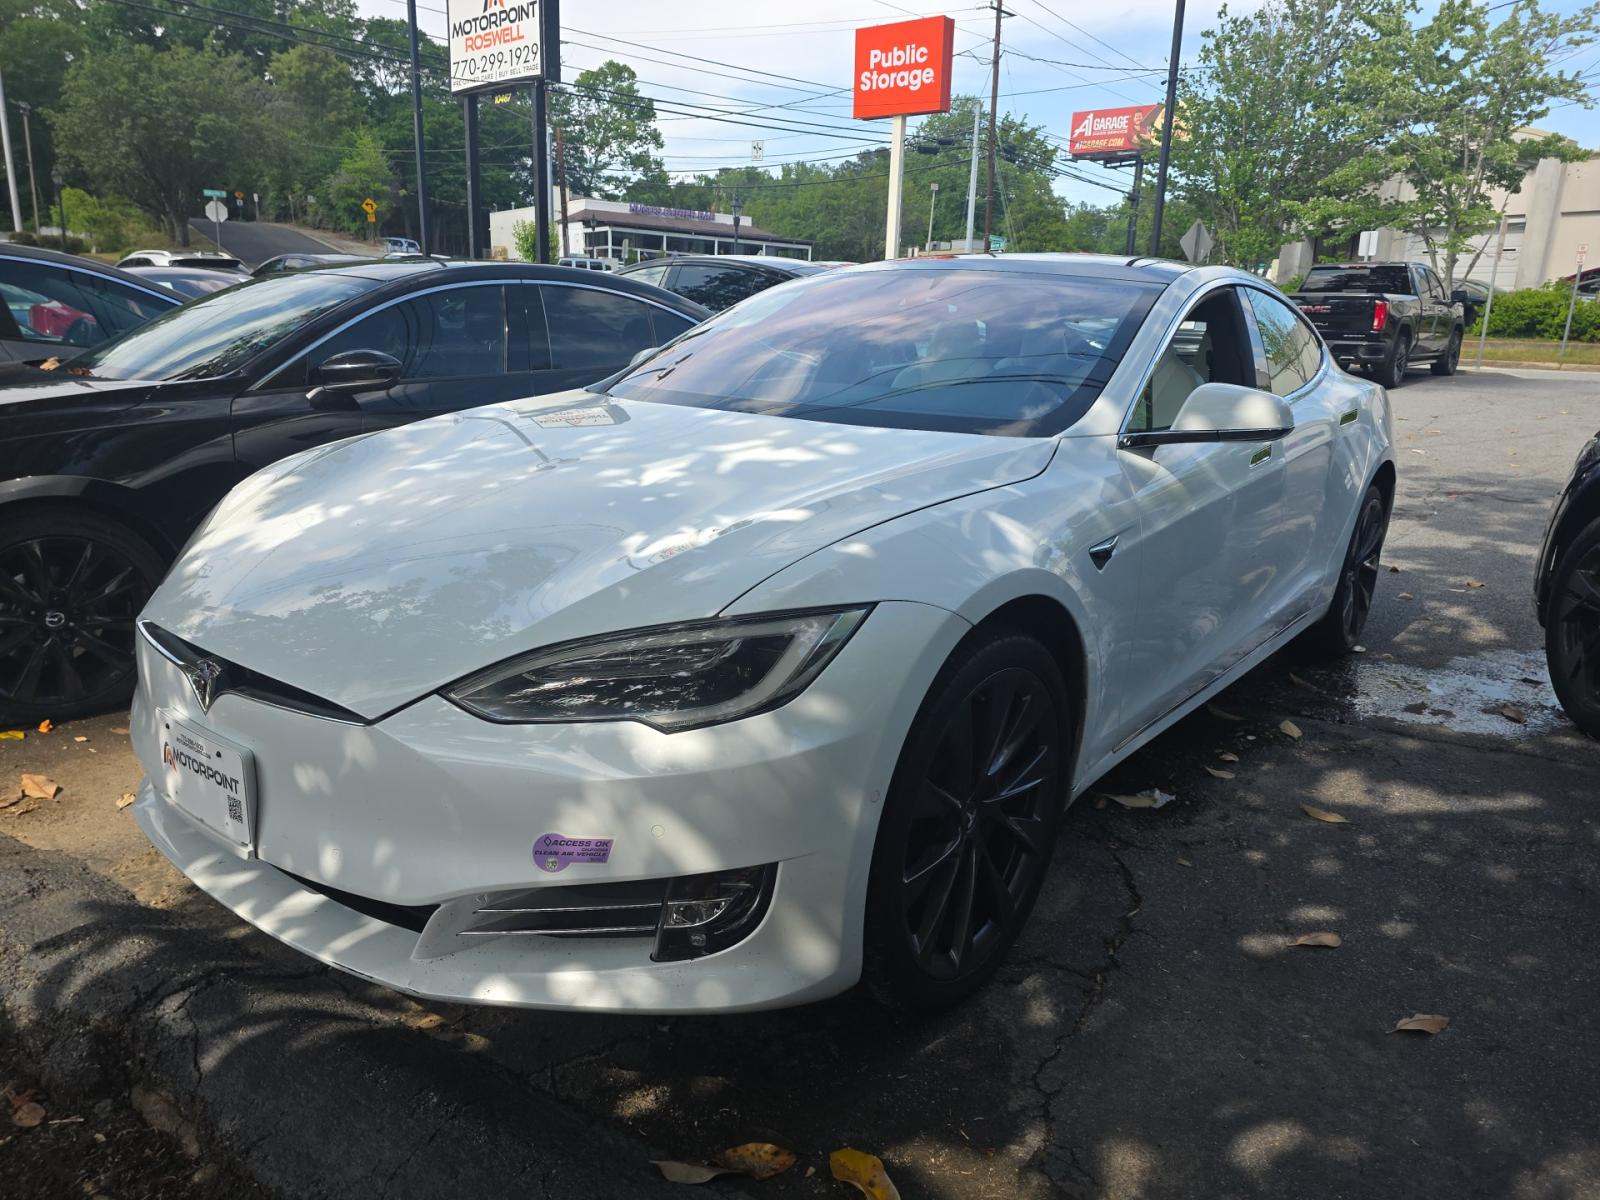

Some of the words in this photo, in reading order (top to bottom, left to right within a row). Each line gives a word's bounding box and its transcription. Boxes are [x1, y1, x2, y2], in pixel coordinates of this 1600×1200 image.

[452, 1, 537, 38] MOTORPOINT
[465, 25, 524, 52] ROSWELL
[453, 43, 538, 78] 770-299-1929
[870, 44, 928, 69] Public
[860, 67, 934, 91] Storage
[1093, 115, 1129, 131] GARAGE
[173, 746, 239, 794] MOTORPOINT
